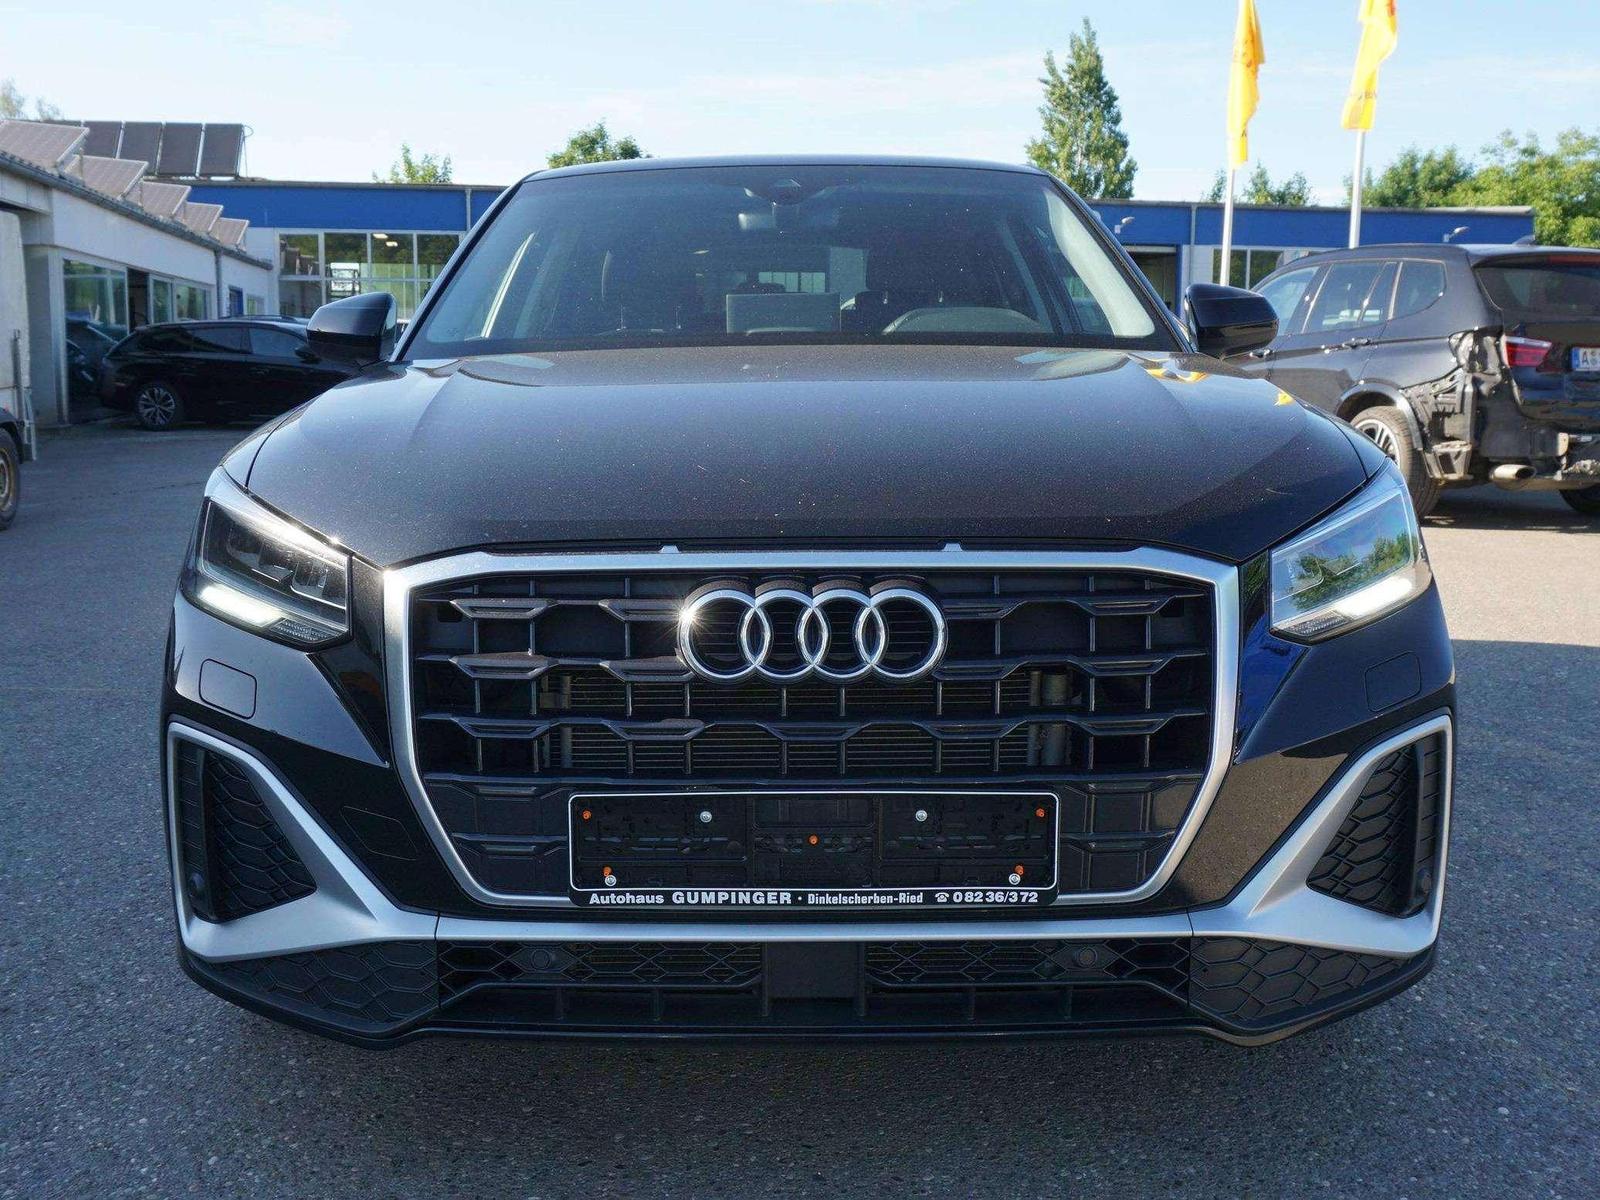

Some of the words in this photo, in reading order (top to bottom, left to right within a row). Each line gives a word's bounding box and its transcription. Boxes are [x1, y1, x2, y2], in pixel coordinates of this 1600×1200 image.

[589, 893, 664, 905] Autohaus
[672, 891, 792, 904] GUMPINGER
[807, 892, 924, 905] Dinkelscherben-Ried
